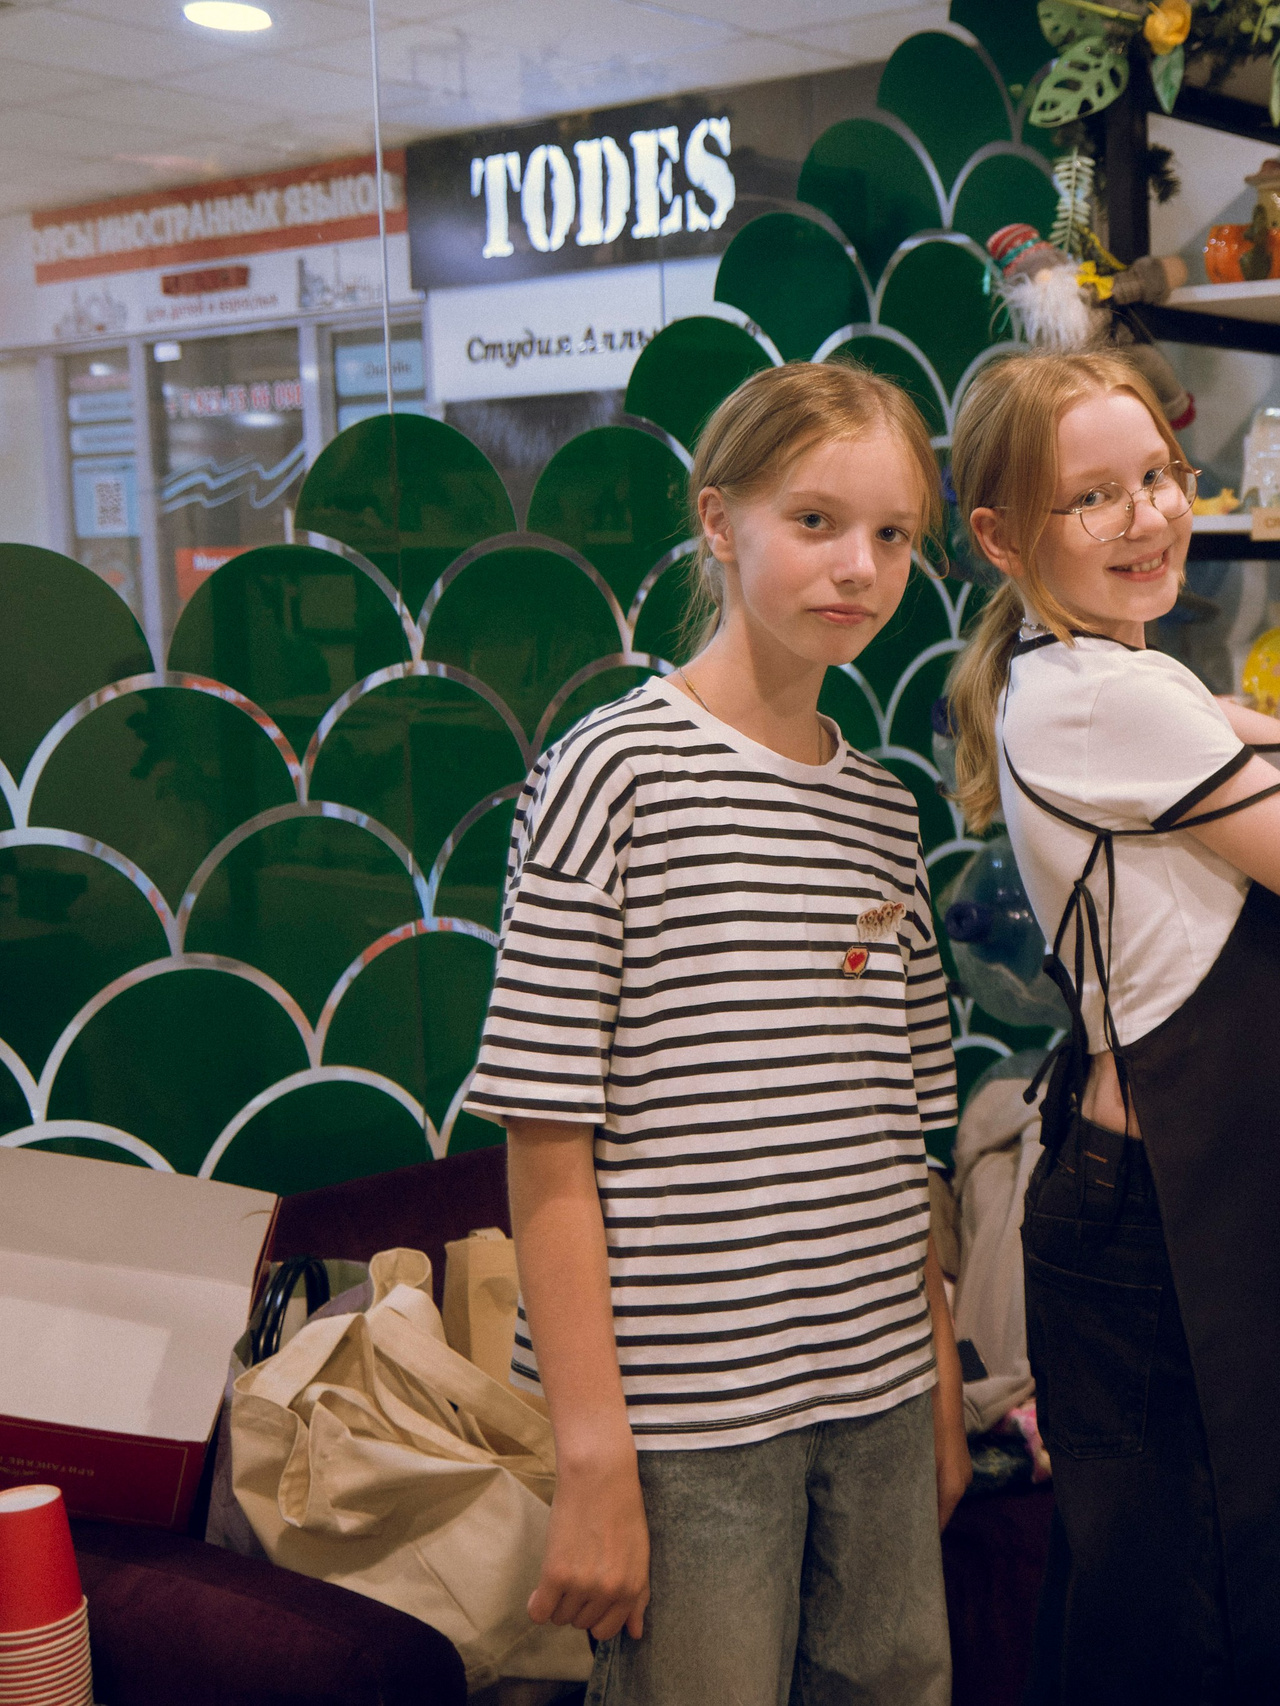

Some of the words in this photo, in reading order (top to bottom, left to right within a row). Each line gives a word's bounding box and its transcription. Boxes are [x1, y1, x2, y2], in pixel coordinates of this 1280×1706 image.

[98, 187, 282, 253] ИНОСТРАННЫХ
[471, 117, 735, 258] TODES
[467, 327, 572, 368] Студия
